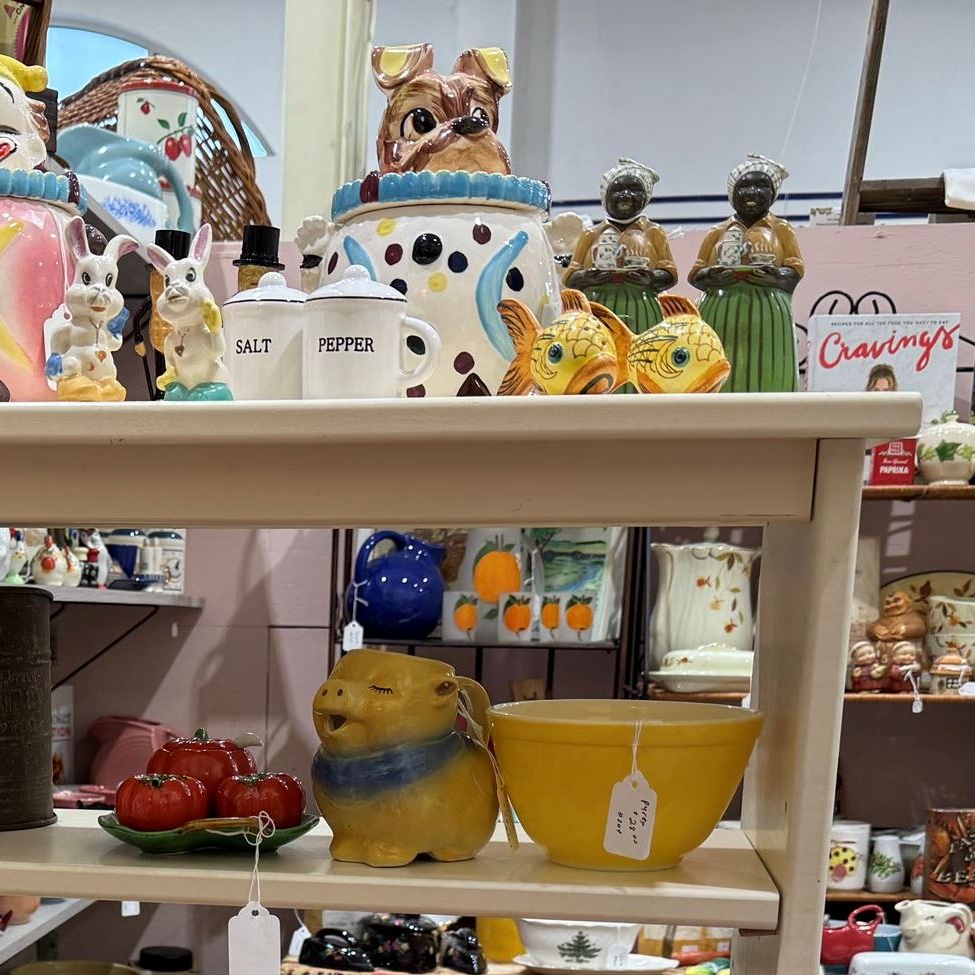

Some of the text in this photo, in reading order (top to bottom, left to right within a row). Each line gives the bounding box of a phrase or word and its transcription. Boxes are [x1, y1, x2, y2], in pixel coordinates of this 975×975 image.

[236, 339, 272, 354] SALT
[318, 336, 374, 353] PEPPER
[818, 324, 961, 372] Cravings
[880, 466, 909, 474] PAPRIKA
